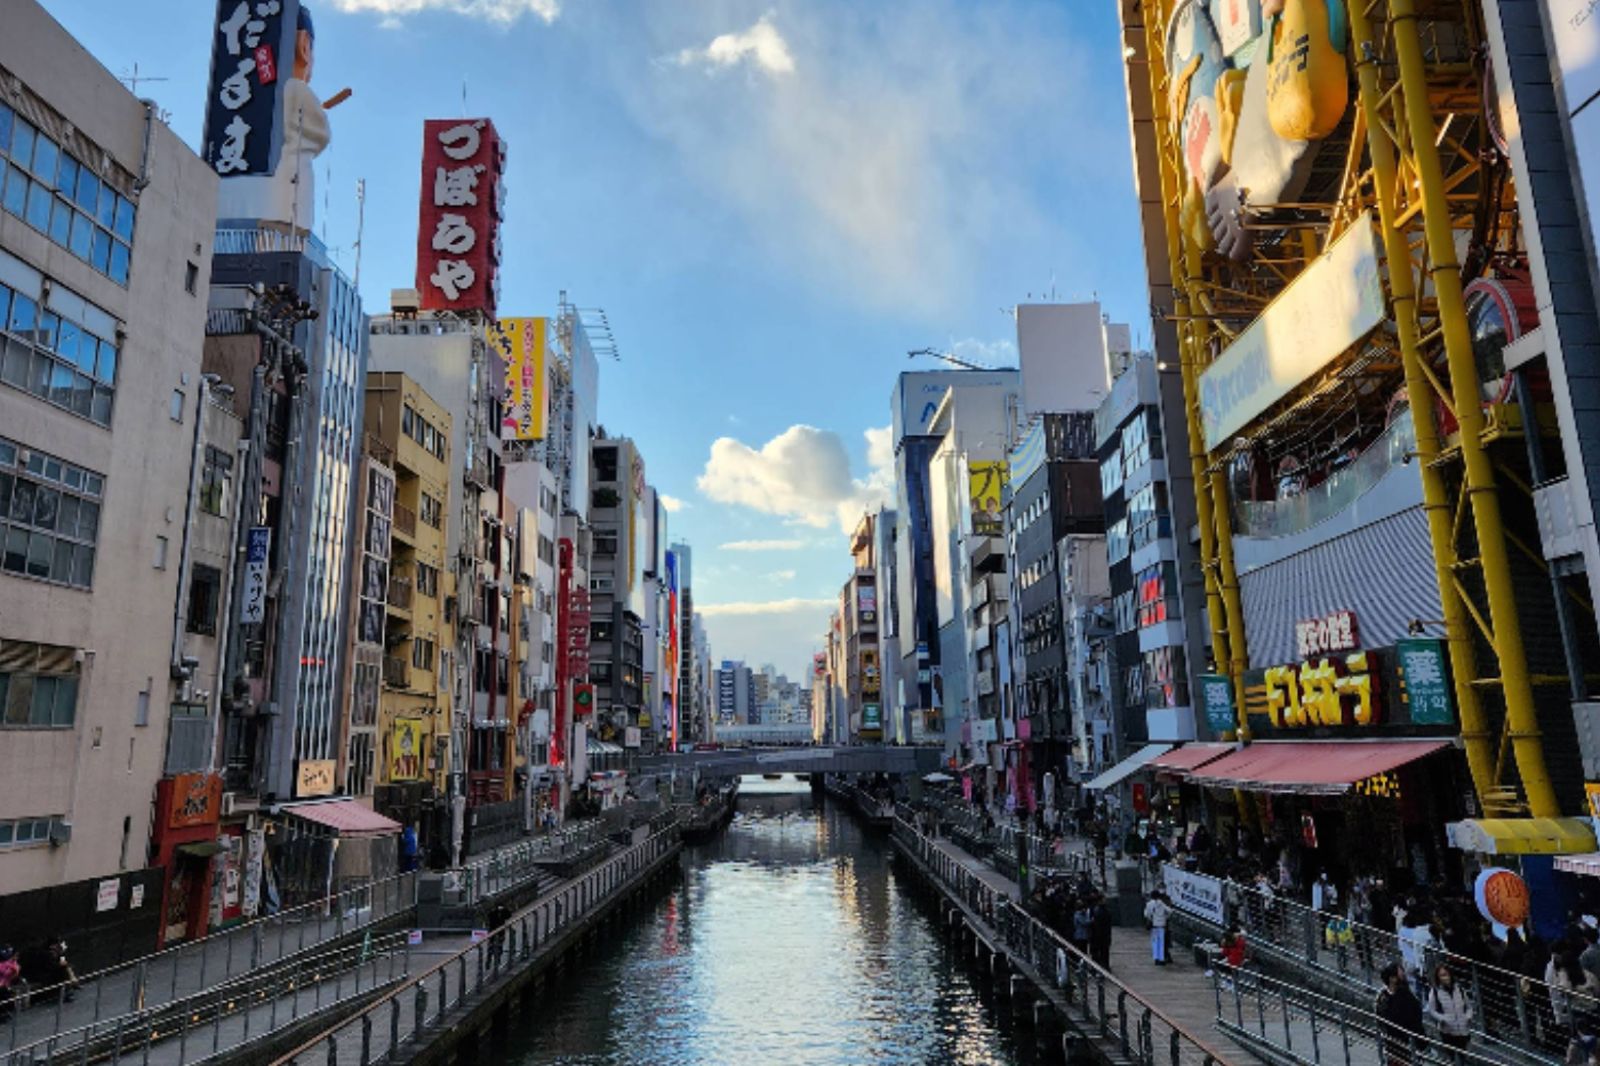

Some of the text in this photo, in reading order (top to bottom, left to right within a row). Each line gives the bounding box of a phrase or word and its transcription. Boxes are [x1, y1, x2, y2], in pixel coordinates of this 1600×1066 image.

[215, 0, 281, 173] だるま
[430, 119, 486, 300] づぼらや
